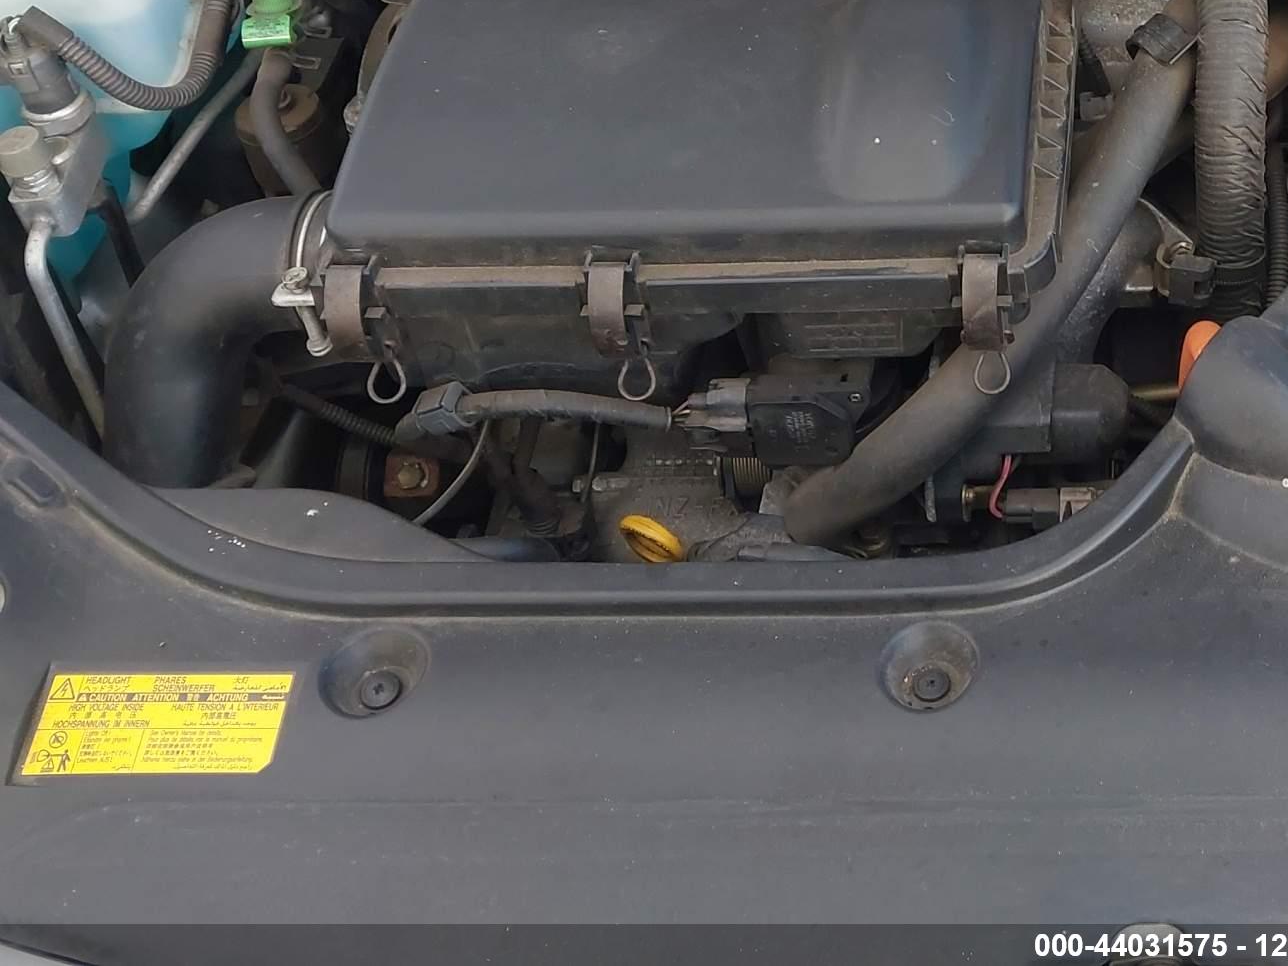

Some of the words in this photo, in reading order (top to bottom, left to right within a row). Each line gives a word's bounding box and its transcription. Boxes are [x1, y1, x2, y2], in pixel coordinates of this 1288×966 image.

[86, 676, 131, 684] HEADLIGHT
[154, 676, 187, 684] PHARES
[152, 684, 215, 692] SCHEINWERFER
[89, 693, 127, 702] CAUTION
[131, 693, 179, 702] ATTENTION
[206, 693, 248, 702] ACHTUNG
[68, 703, 86, 712] HIGH
[89, 703, 119, 712] VOLTAGE
[121, 703, 144, 711] INSIDE
[171, 703, 194, 712] HAUTE
[197, 703, 226, 711] TENSION
